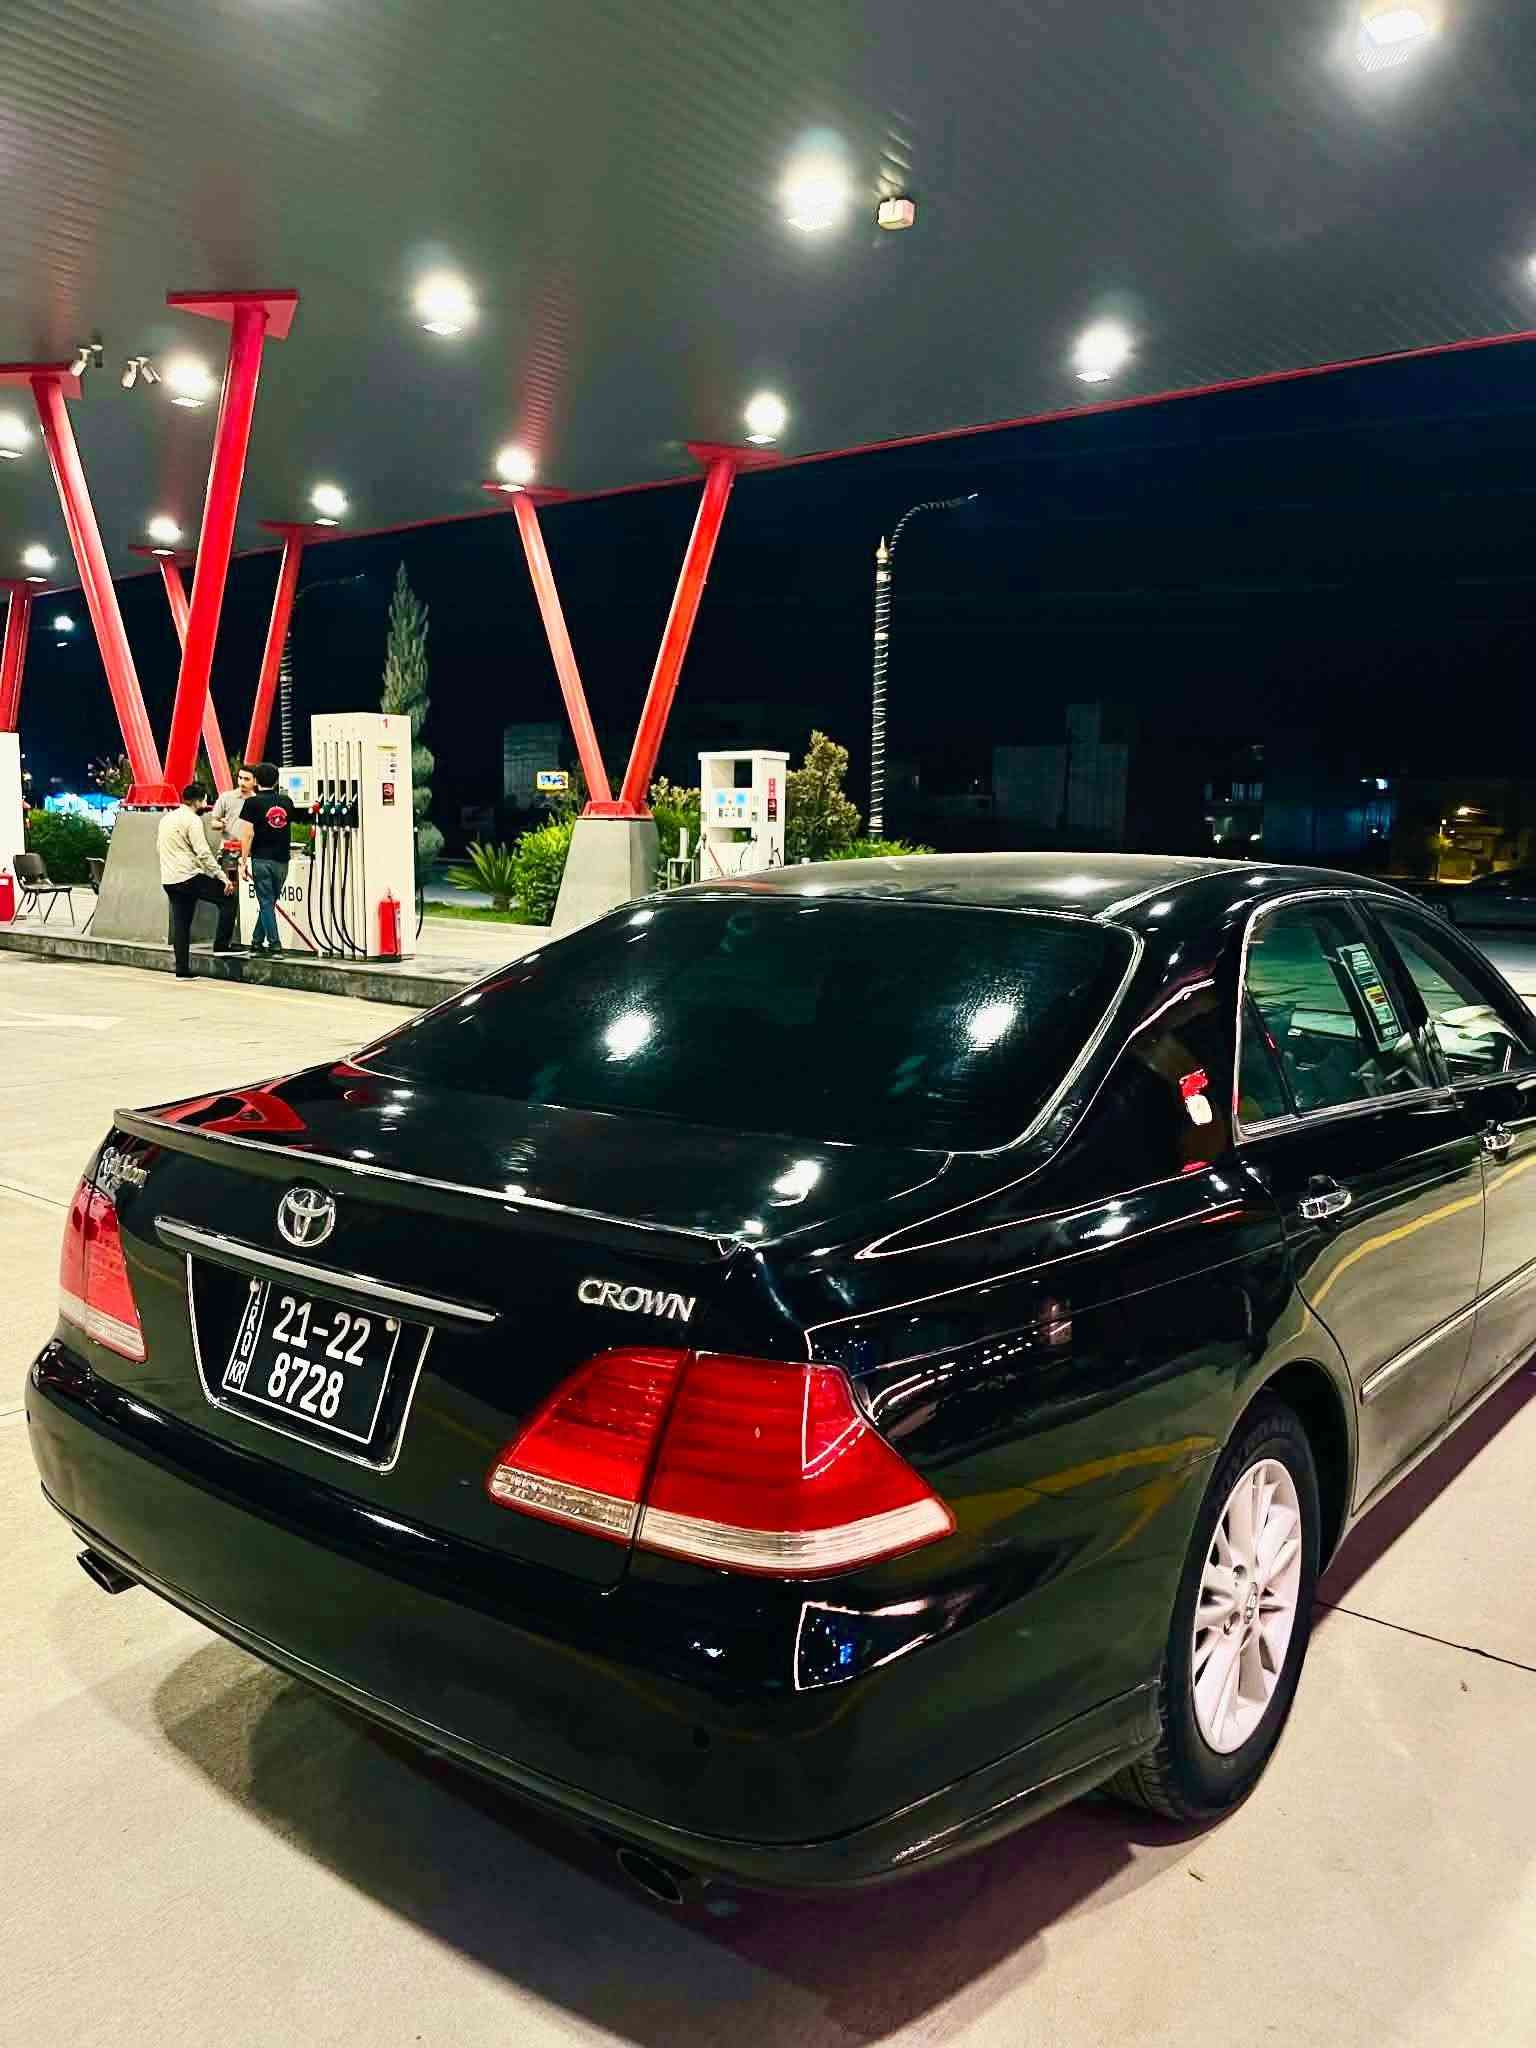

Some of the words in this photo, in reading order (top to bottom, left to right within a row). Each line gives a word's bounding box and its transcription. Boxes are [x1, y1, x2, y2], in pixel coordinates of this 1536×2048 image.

[272, 1295, 371, 1367] 21-22
[577, 1279, 697, 1322] CROWN
[267, 1352, 344, 1419] 8728
